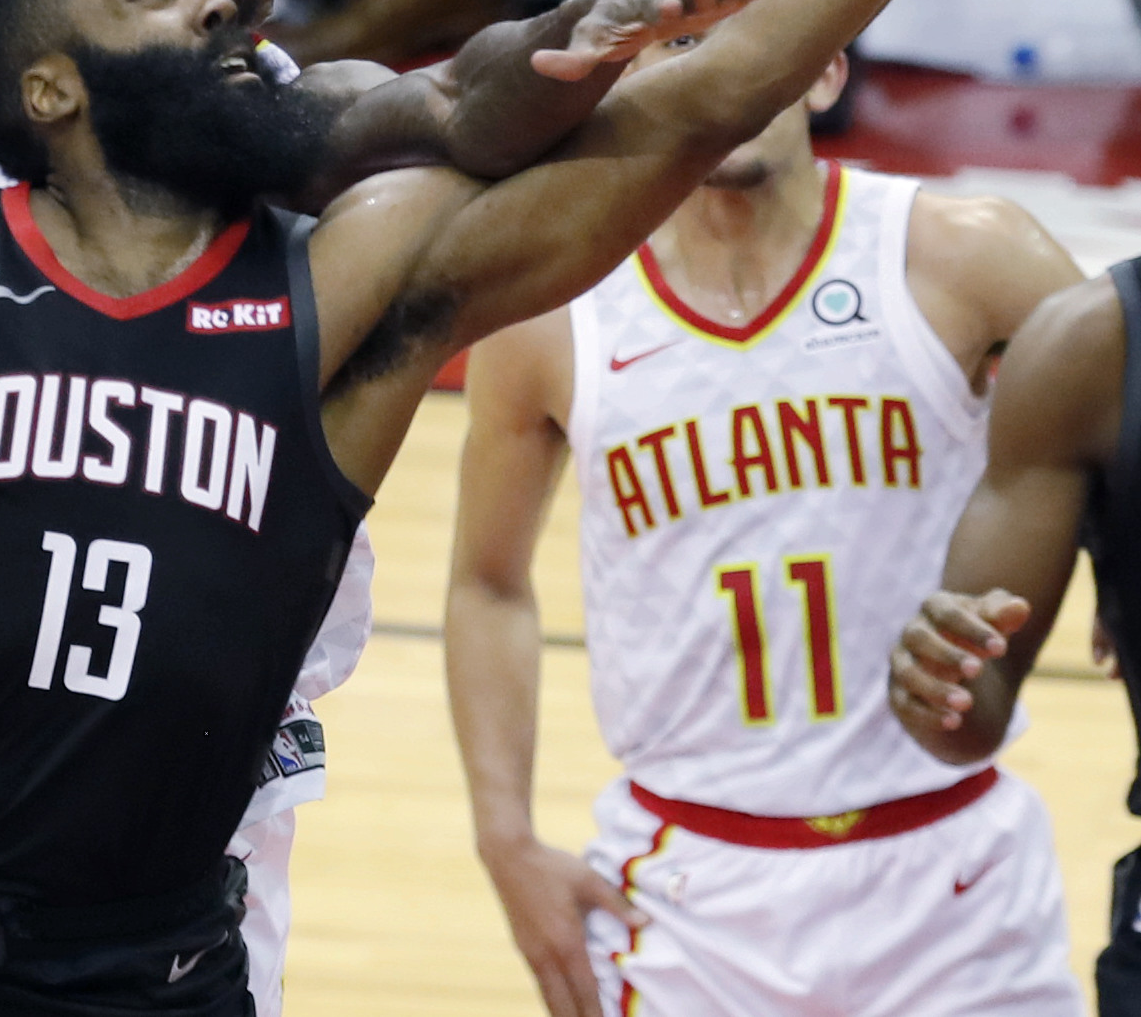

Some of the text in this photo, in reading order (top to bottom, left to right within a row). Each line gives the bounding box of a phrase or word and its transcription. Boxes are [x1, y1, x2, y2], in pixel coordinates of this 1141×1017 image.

[604, 395, 923, 539] ATLANTA
[27, 529, 153, 702] 13
[713, 552, 845, 730] 11
